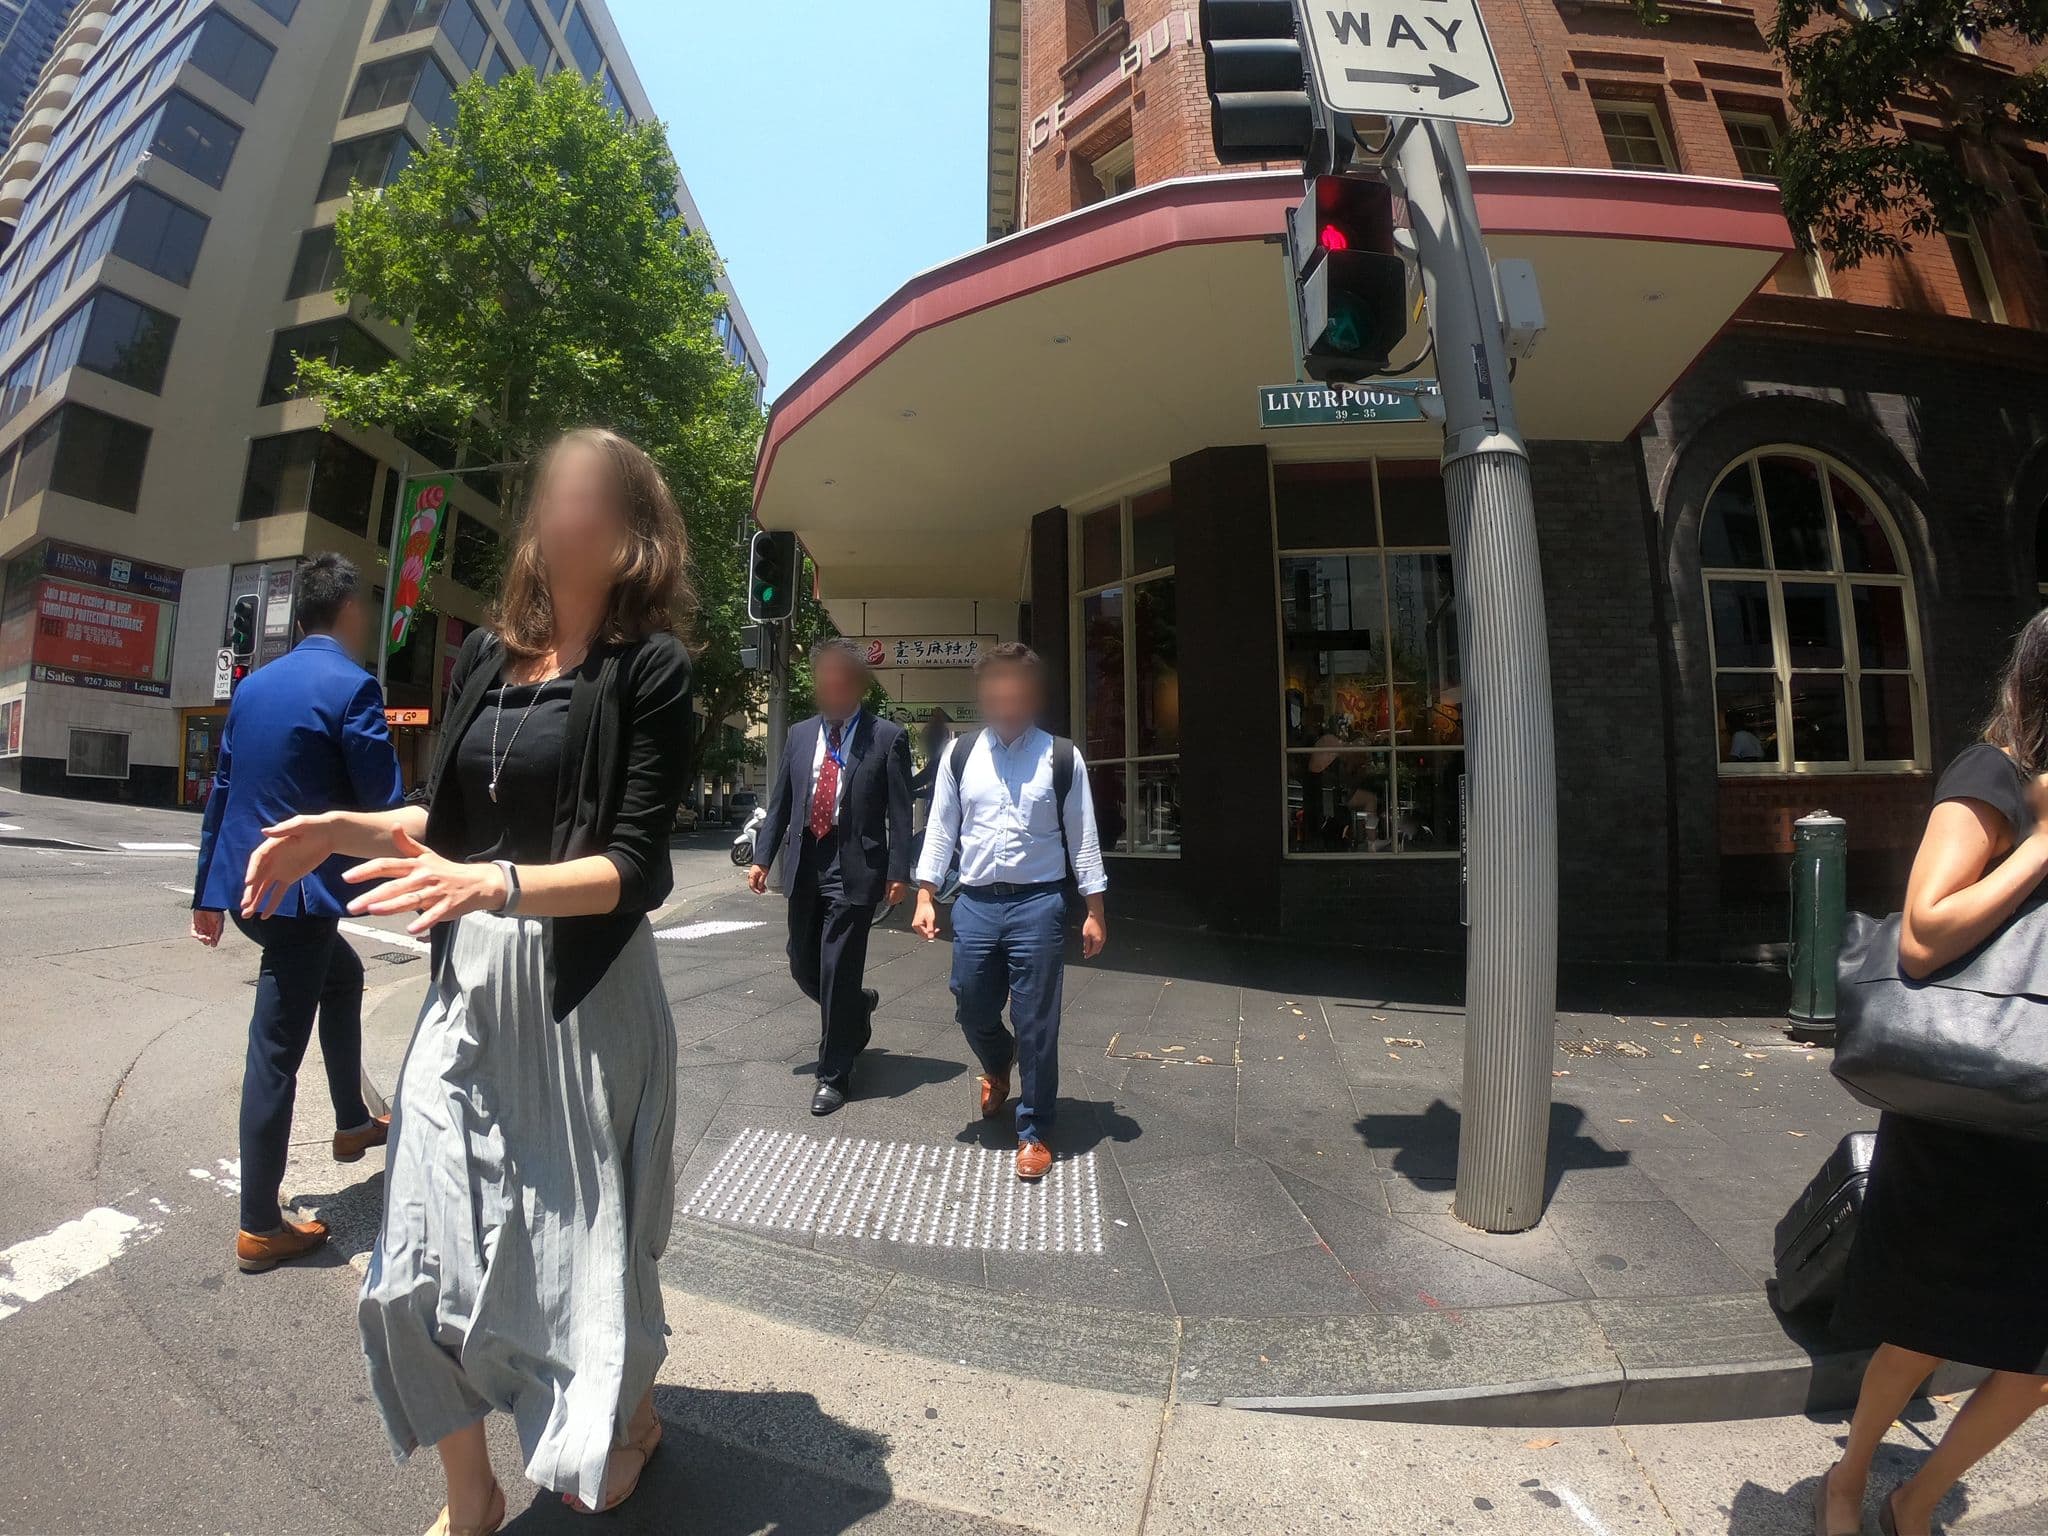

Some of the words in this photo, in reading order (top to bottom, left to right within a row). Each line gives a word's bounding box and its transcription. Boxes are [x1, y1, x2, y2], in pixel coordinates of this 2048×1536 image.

[1326, 10, 1463, 53] WAY
[1119, 11, 1194, 81] BUI
[1267, 389, 1400, 411] LIVERPOOL
[1335, 410, 1347, 419] 39
[1364, 409, 1376, 418] 35
[56, 552, 98, 571] HENSON
[47, 670, 75, 683] Sales
[84, 676, 102, 687] 9267
[134, 681, 164, 695] Leasing
[219, 672, 230, 681] NO
